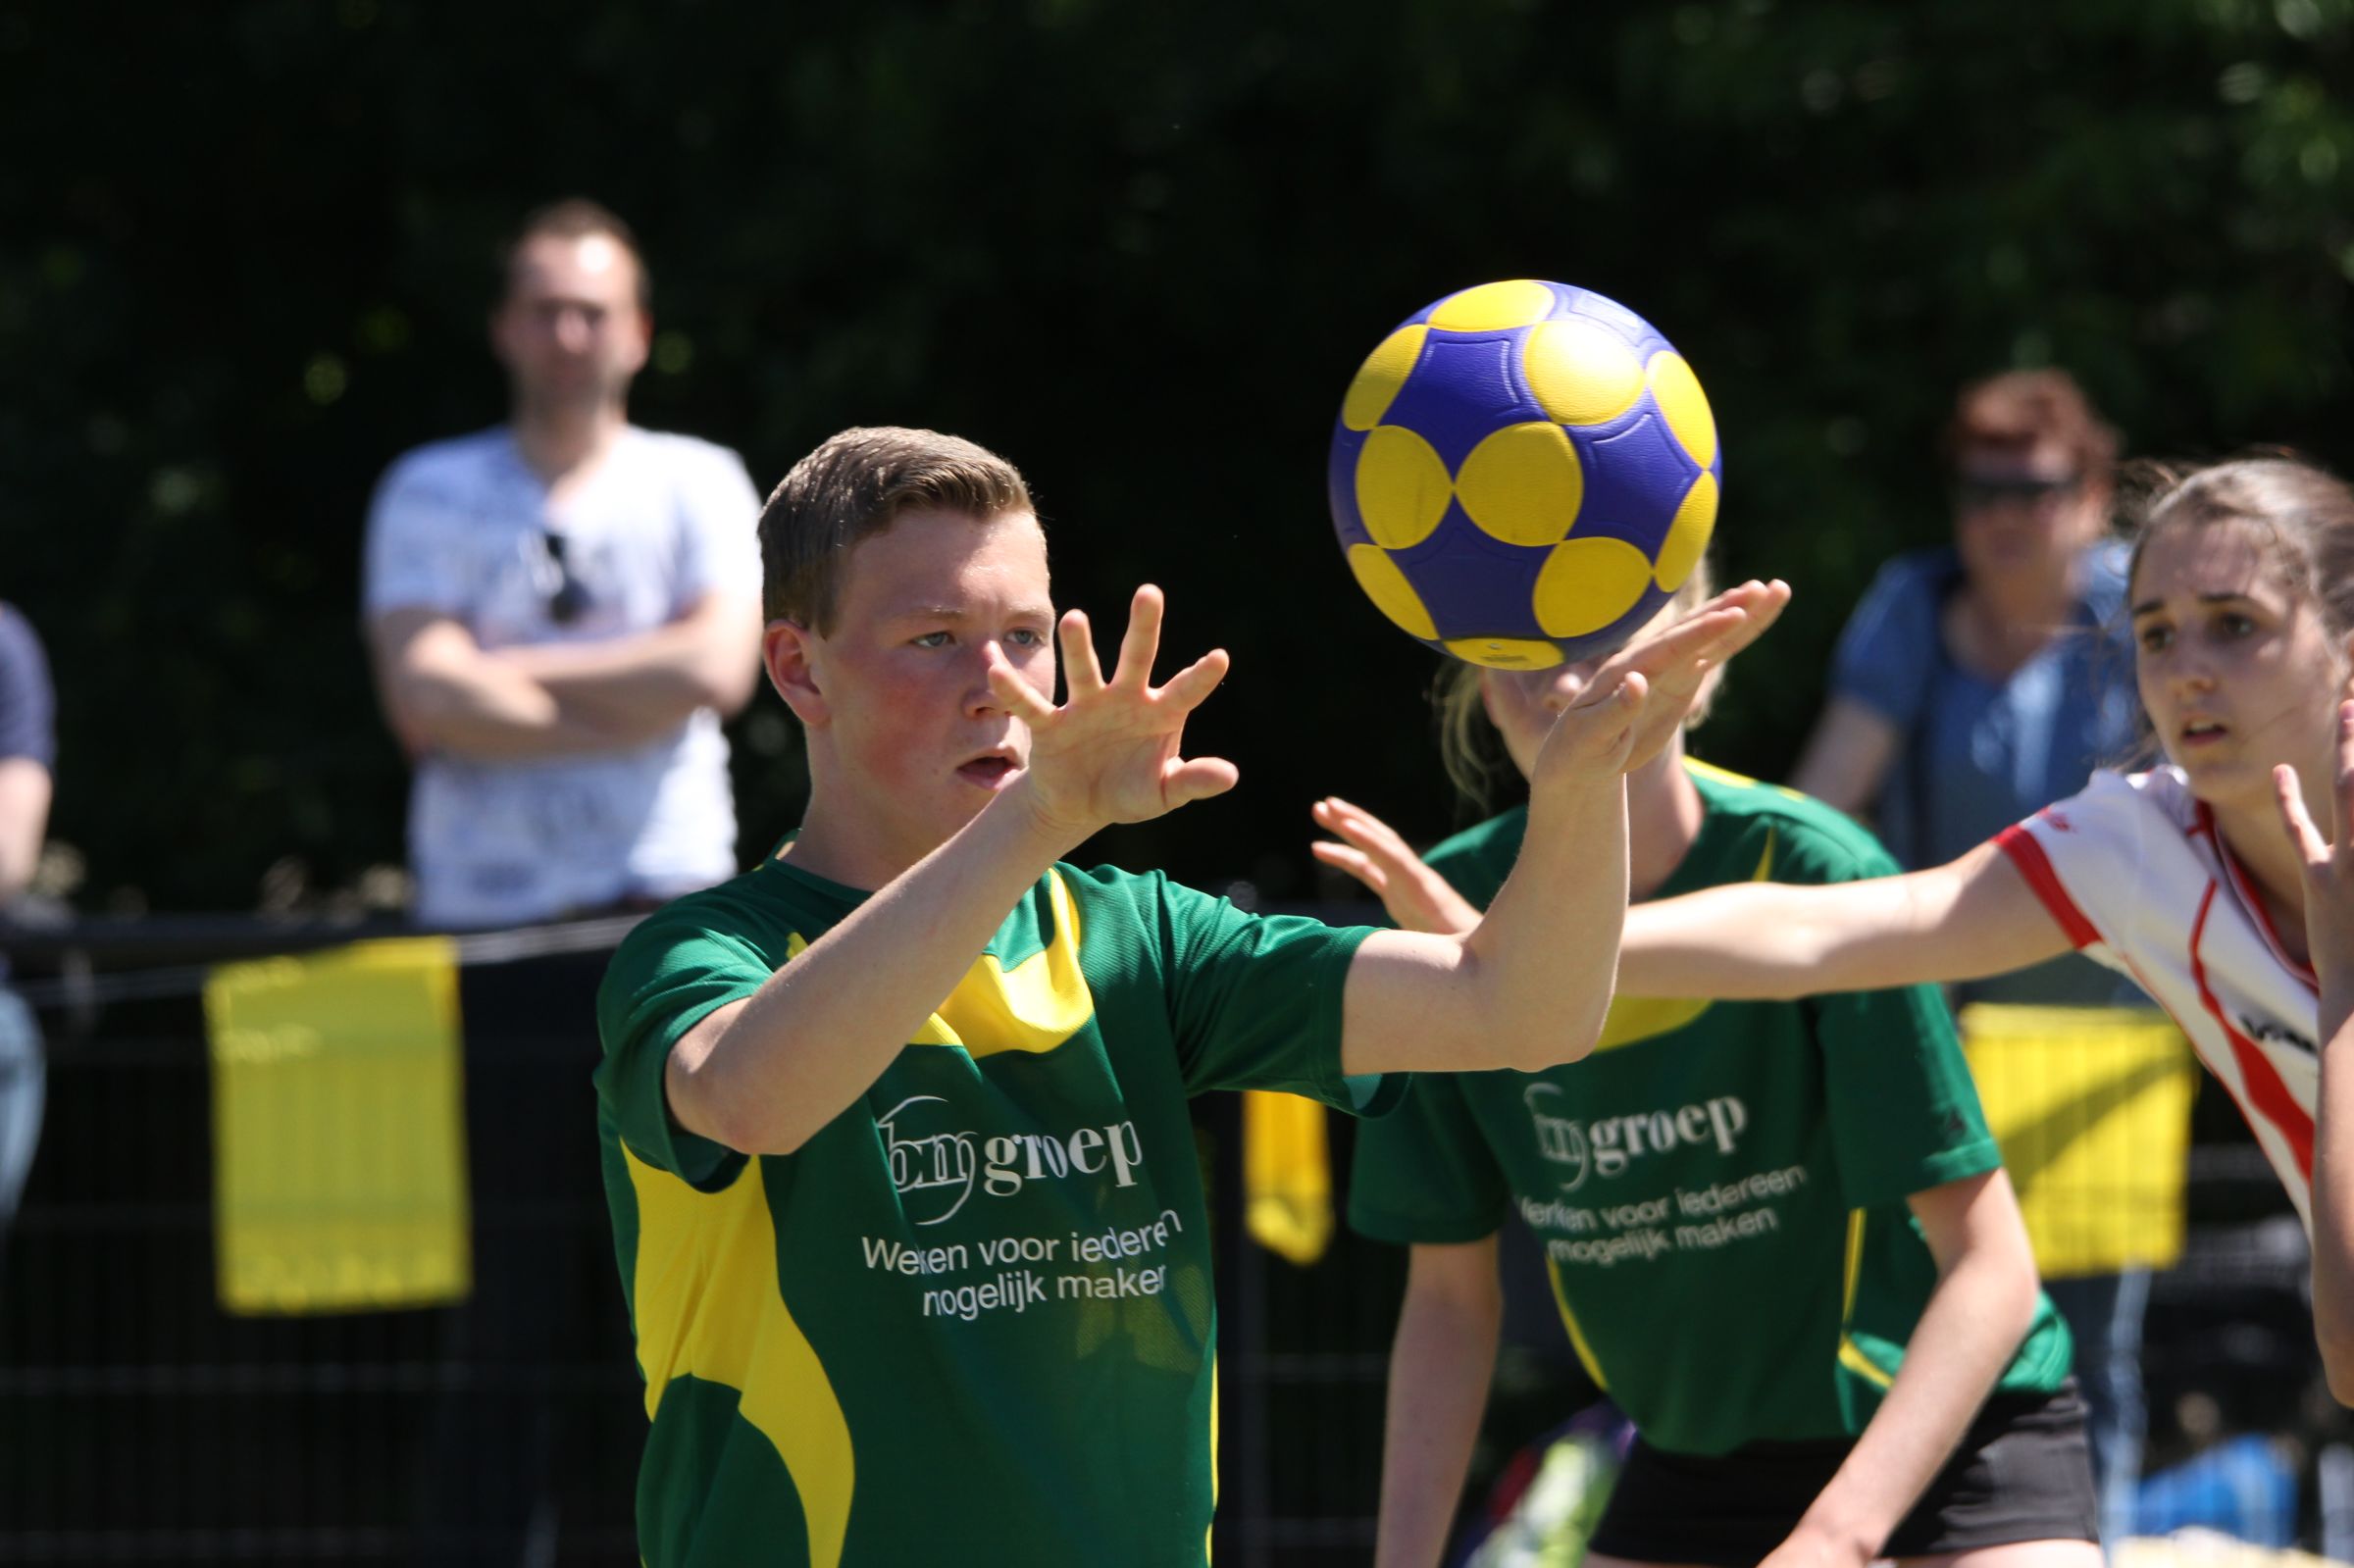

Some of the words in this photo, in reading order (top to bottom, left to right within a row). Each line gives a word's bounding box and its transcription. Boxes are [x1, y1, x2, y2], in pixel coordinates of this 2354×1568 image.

[984, 1120, 1142, 1196] groep
[1589, 1095, 1748, 1178] groep
[1600, 1195, 1669, 1230] voor
[1674, 1165, 1807, 1216] iedereen
[978, 1236, 1060, 1266] voor
[1547, 1228, 1670, 1267] mogelijk
[1674, 1207, 1779, 1249] maken
